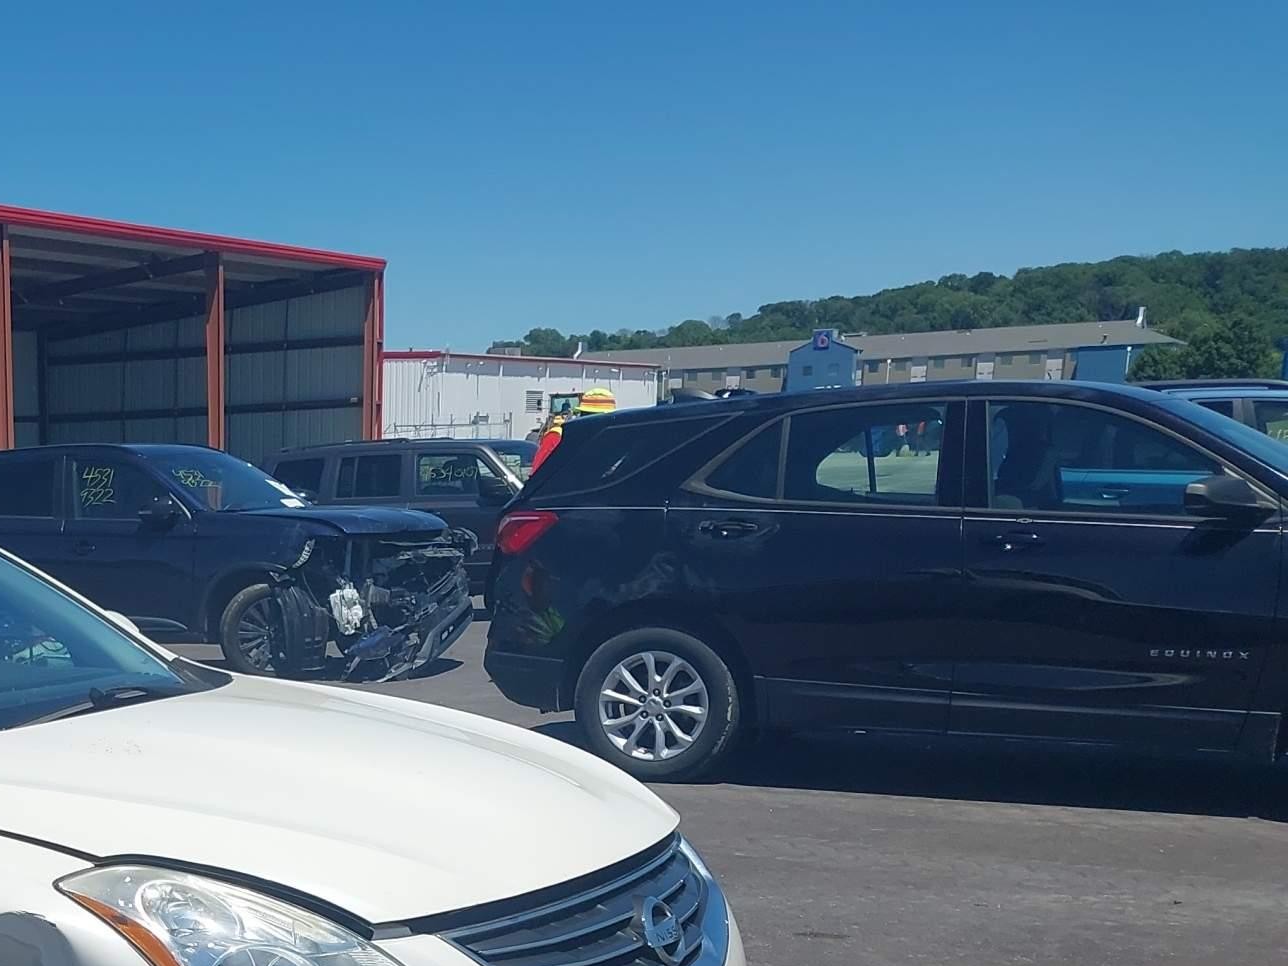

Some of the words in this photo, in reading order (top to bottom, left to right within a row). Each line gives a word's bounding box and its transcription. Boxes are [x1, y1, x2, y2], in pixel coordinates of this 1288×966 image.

[817, 331, 830, 348] 6
[82, 467, 114, 489] 4531
[1149, 648, 1250, 660] EQUINOX
